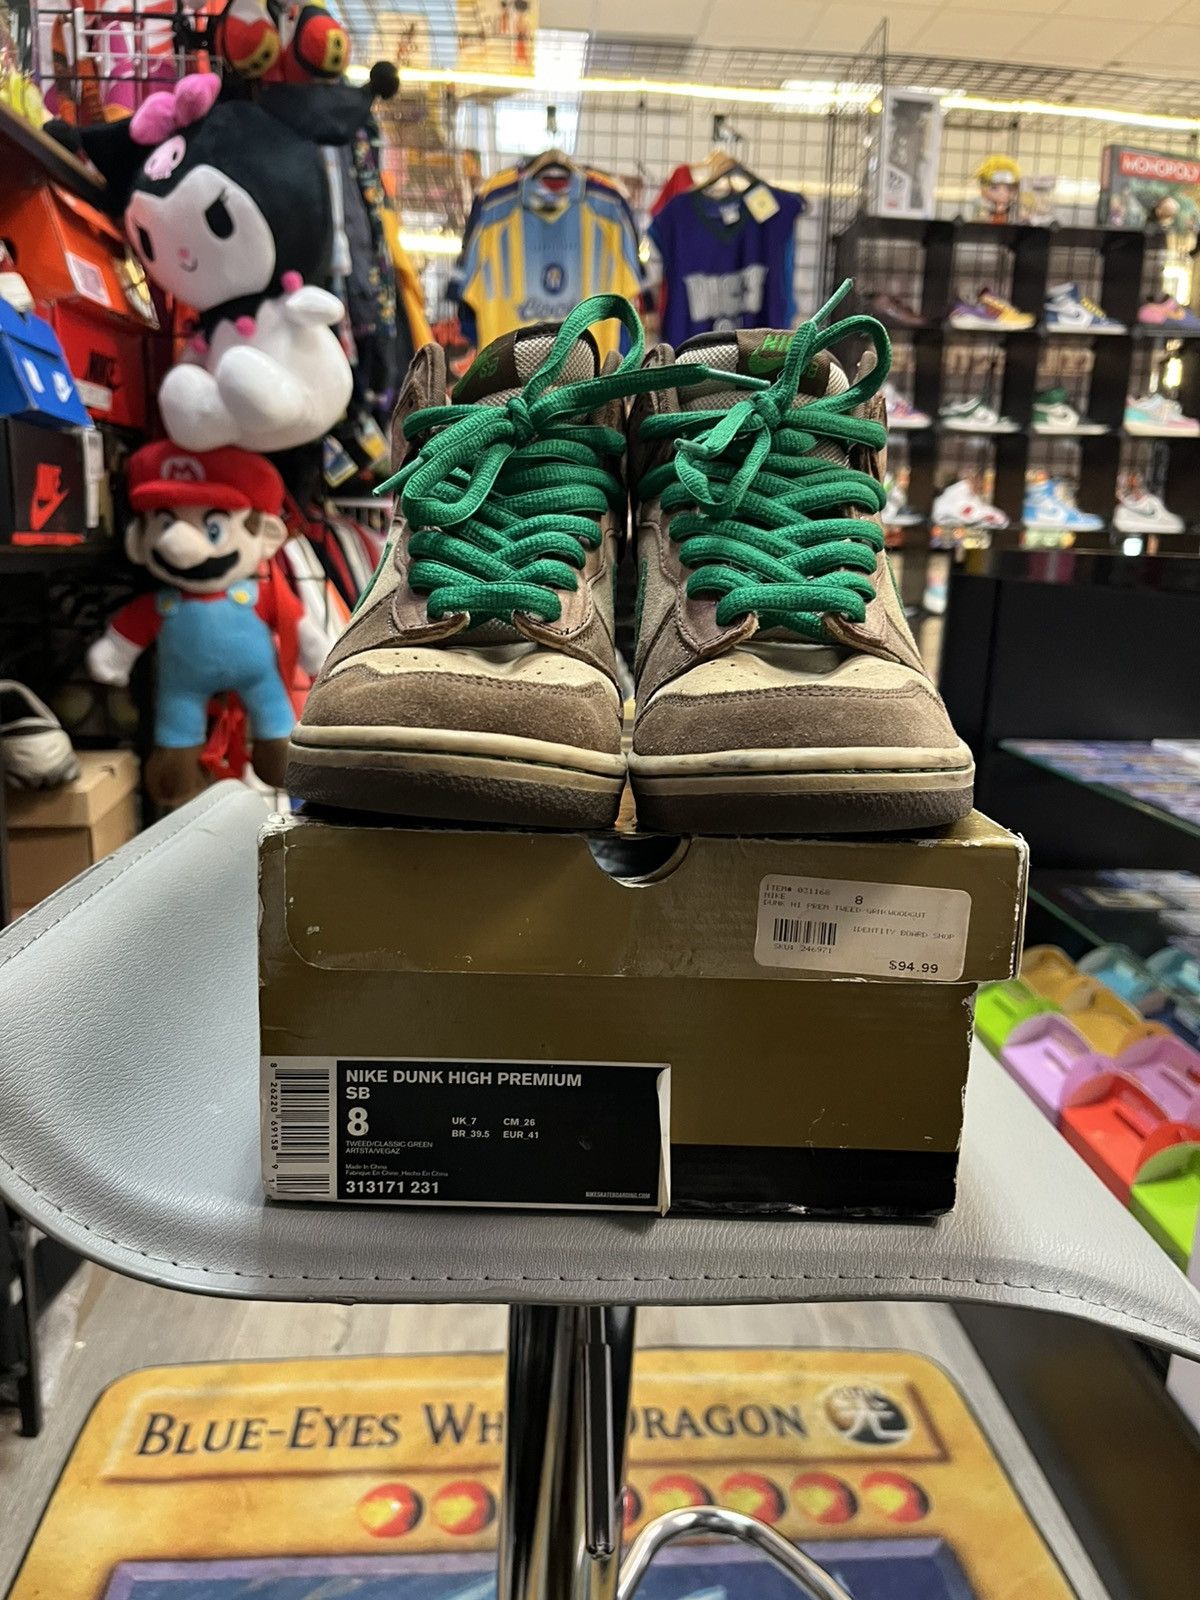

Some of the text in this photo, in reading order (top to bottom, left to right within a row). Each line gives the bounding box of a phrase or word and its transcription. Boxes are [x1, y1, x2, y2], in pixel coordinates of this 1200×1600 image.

[763, 891, 786, 900] NIKE
[854, 895, 864, 905] 8
[888, 959, 939, 975] $94.99
[346, 1069, 582, 1087] NIKE DUNK HIGH PREMIUM
[270, 1081, 279, 1114] 26220
[345, 1086, 371, 1100] SB
[346, 1106, 370, 1137] 8
[271, 1120, 279, 1151] 69158
[345, 1140, 406, 1148] TWEED/CLASSIC
[346, 1180, 440, 1195] 313171 231
[137, 1406, 401, 1456] BLUE-EYES
